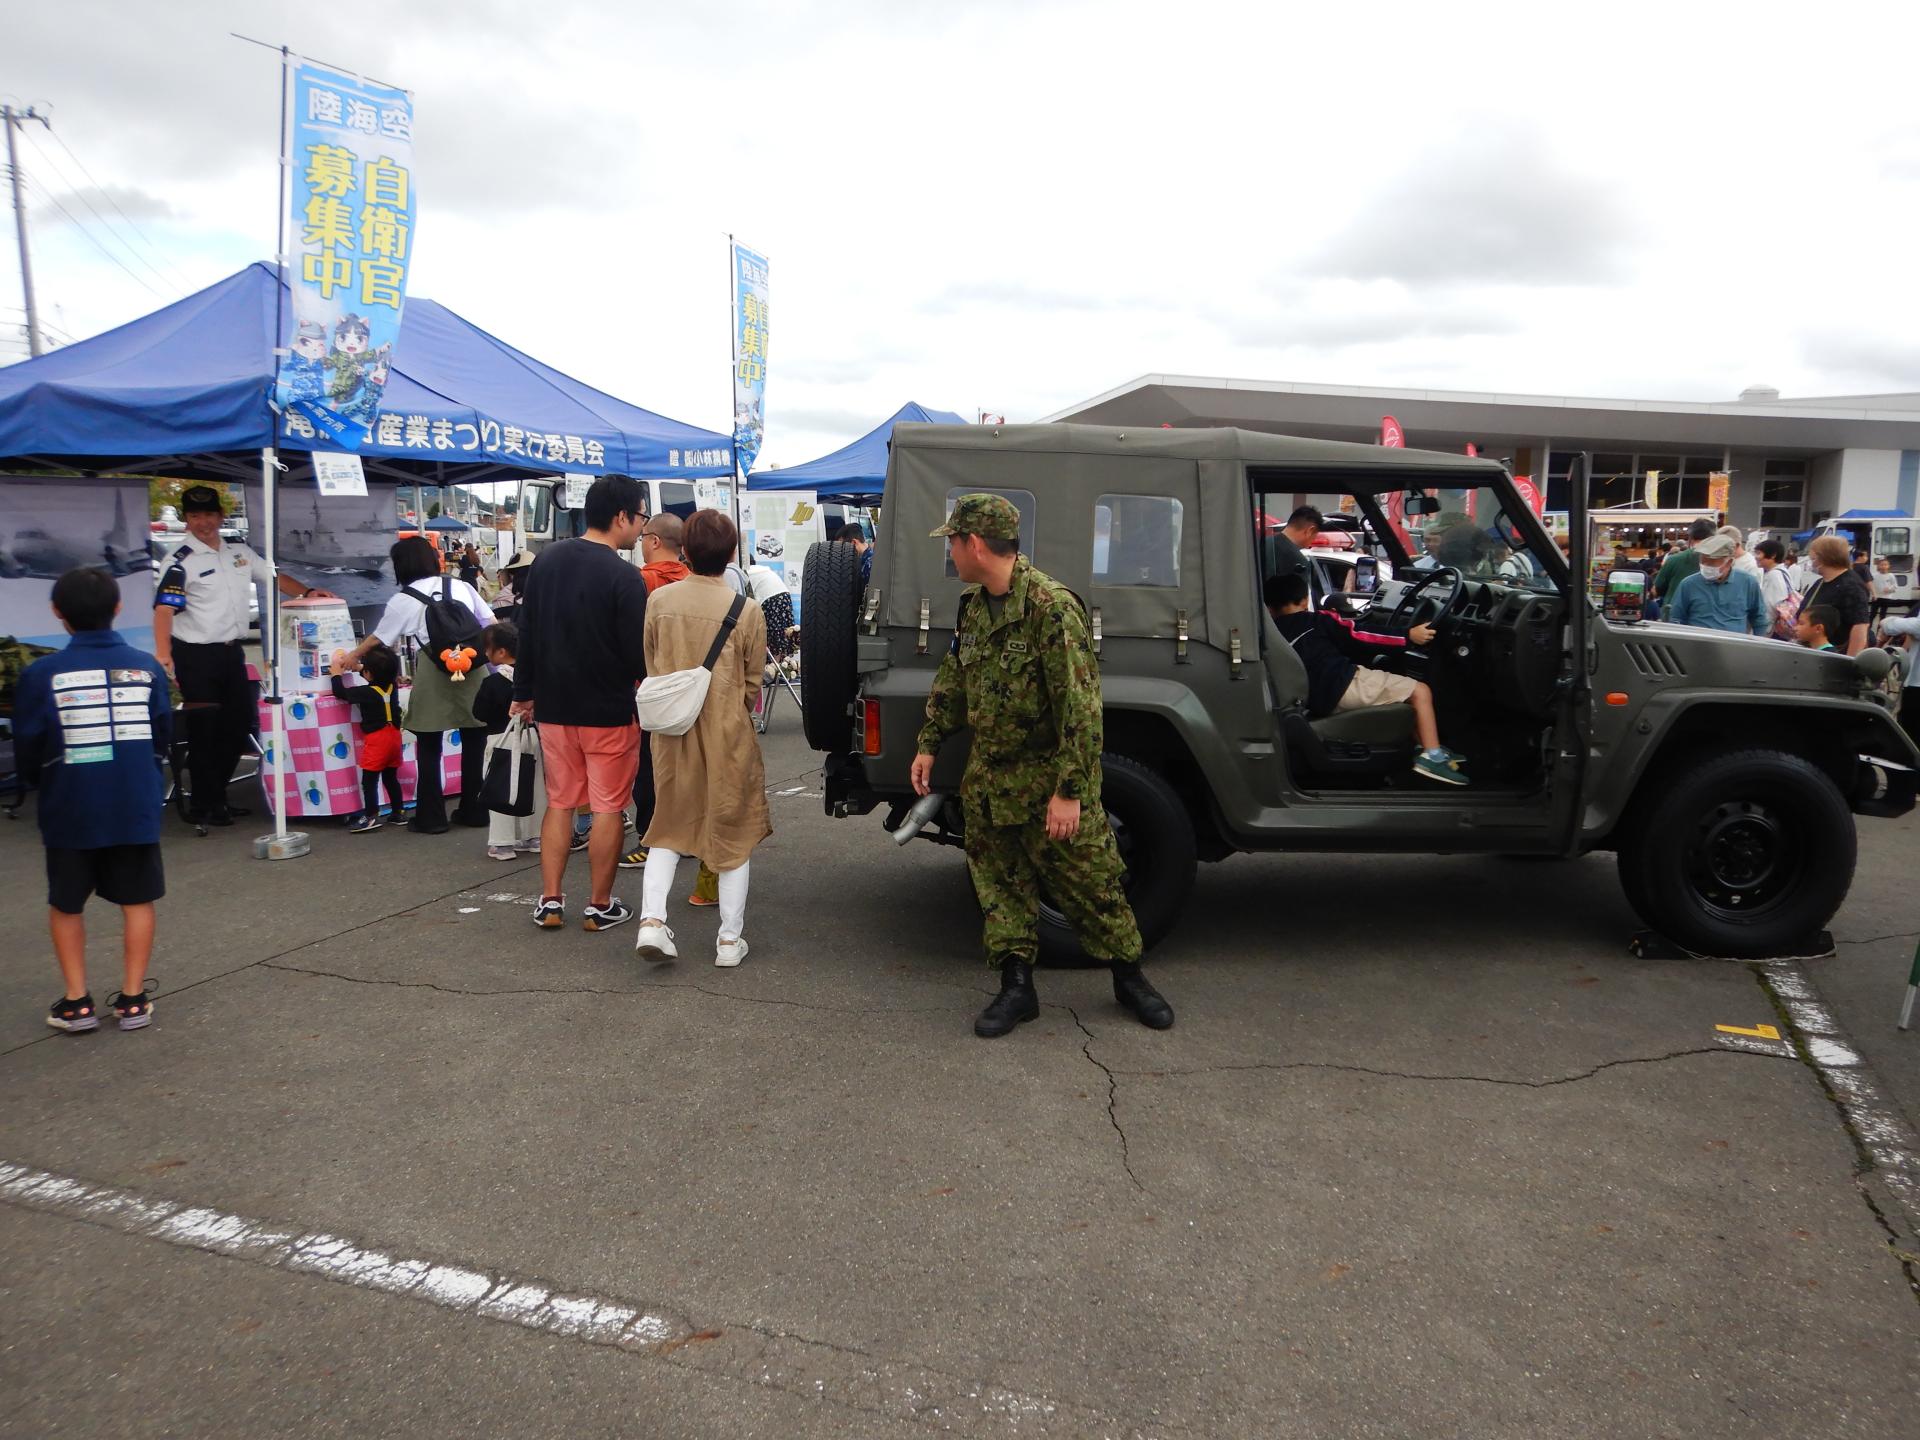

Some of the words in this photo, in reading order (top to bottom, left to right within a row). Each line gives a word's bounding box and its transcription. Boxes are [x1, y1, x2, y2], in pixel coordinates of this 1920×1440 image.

[307, 87, 411, 142] 陸海空
[301, 144, 358, 301] 募集中
[359, 155, 410, 310] 自衛官
[737, 292, 761, 388] 募集中
